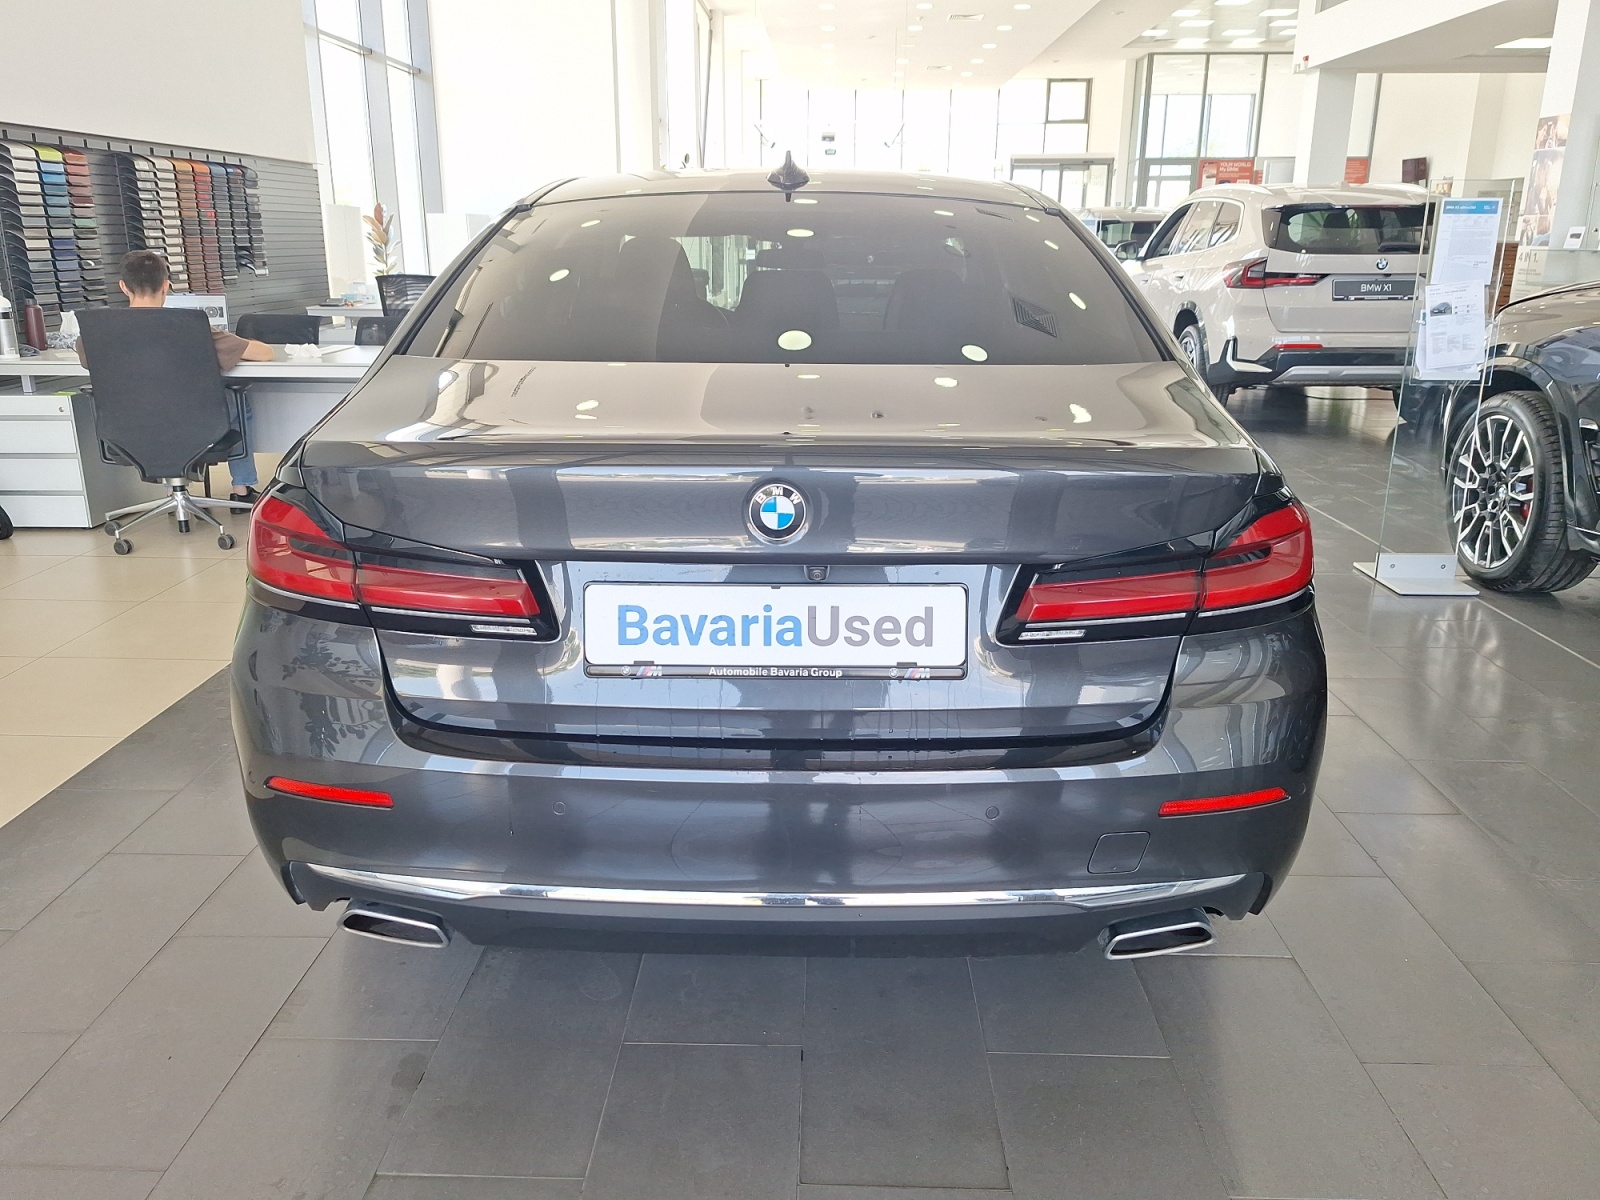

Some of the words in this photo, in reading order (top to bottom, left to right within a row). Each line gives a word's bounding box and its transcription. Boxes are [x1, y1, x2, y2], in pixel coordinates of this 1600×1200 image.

[1360, 283, 1382, 292] BMW
[1383, 283, 1392, 292] X1
[755, 486, 802, 505] BMW
[617, 604, 934, 647] BavariaUsed
[708, 666, 768, 676] Automobile
[770, 667, 809, 677] Bavaria
[810, 667, 843, 679] Group
